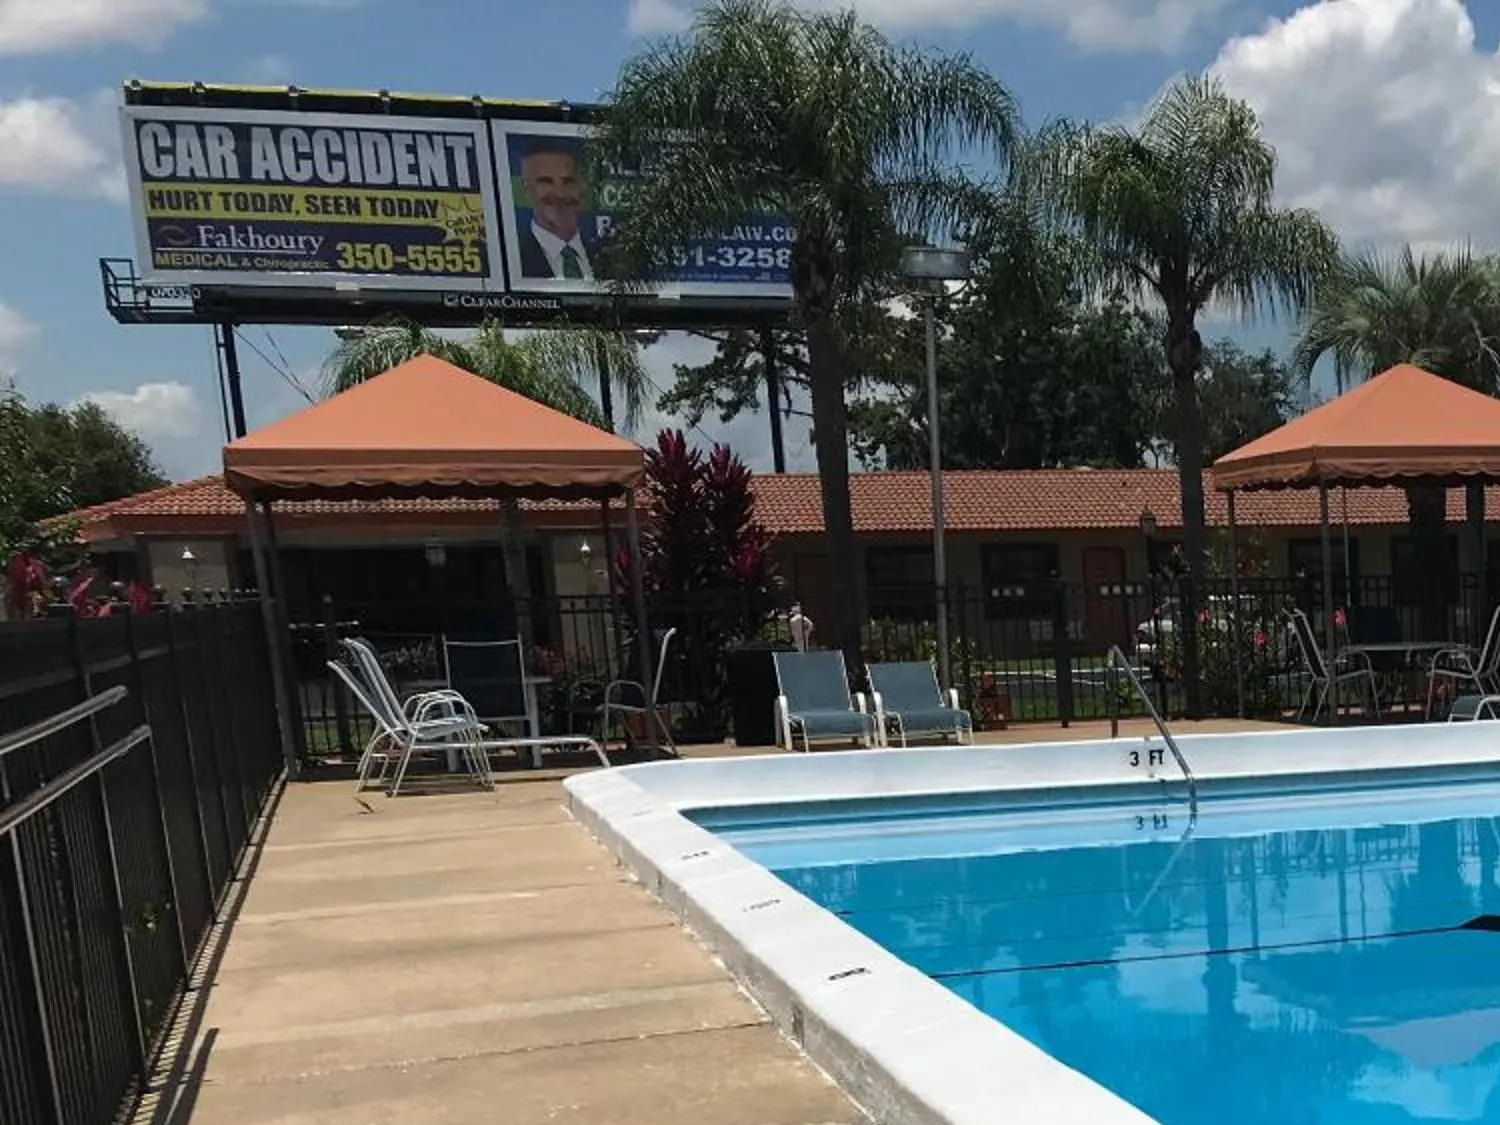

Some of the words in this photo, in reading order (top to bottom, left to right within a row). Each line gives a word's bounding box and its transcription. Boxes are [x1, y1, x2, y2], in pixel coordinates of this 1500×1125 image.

[139, 122, 240, 178] CAR
[251, 126, 473, 188] ACCIDENT
[150, 189, 212, 211] HURT
[218, 191, 300, 216] TODAY,
[304, 194, 361, 216] SEEN
[367, 196, 438, 219] TODAY
[196, 225, 324, 255] Fakhoury
[156, 252, 239, 268] MEDICAL
[336, 242, 481, 273] 350-5555
[1129, 751, 1140, 767] 3
[1149, 749, 1165, 766] FT
